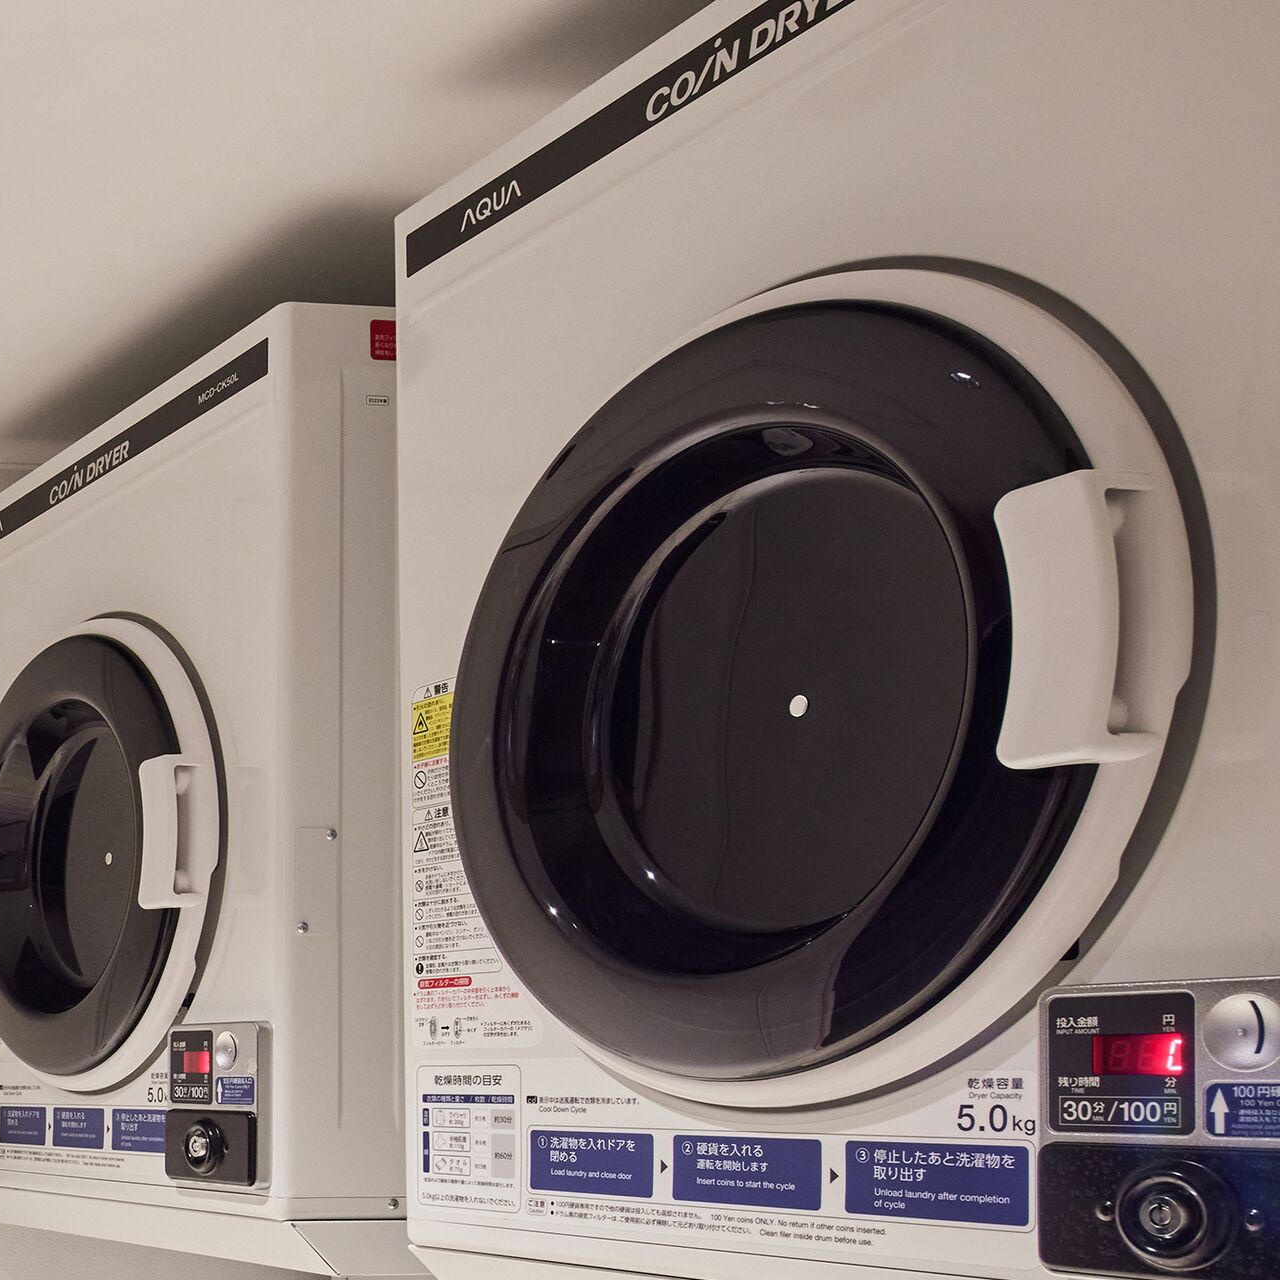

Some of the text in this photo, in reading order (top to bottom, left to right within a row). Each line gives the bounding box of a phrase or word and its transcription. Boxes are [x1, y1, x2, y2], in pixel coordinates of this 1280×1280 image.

[461, 180, 521, 233] AQUA
[85, 440, 130, 482] DRYER
[433, 682, 449, 695] 警告
[434, 806, 449, 819] 注意
[1056, 1016, 1099, 1028] 投入金額
[1162, 1014, 1175, 1026] 円
[434, 1074, 503, 1086] 乾燥時間の目安
[967, 1077, 1024, 1090] 乾燥容量
[1058, 1076, 1100, 1088] 残り時間
[1164, 1076, 1177, 1088] 分
[147, 1087, 164, 1103] 5.0
[968, 1091, 1023, 1101] Dryer Capacity
[1240, 1099, 1275, 1107] 100 Yen
[539, 1105, 552, 1113] Cool
[570, 1106, 587, 1115] Cycle
[494, 1116, 512, 1124] 約30分
[957, 1104, 1036, 1136] 5.0 kg
[549, 1136, 636, 1152] 洗濯物を入れドアを
[696, 1142, 764, 1157] 硬貨を入れる
[494, 1152, 513, 1161] 約60分
[549, 1150, 578, 1163] 閉める
[873, 1148, 1016, 1169] 停止したあと洗濯物を
[696, 1158, 769, 1172] 運転を開始します
[550, 1168, 633, 1180] Load laundry and close door
[873, 1165, 927, 1182] 取り出す
[696, 1176, 796, 1192] Insert coins to start the cycle
[874, 1187, 1010, 1205] Unload laundry after completion
[873, 1199, 906, 1210] of cycle
[710, 1213, 722, 1221] 100
[723, 1214, 735, 1222] Yen
[736, 1216, 754, 1225] coins
[755, 1217, 776, 1226] ONLY.
[777, 1219, 788, 1227] No
[789, 1220, 808, 1229] return
[816, 1222, 834, 1231] other
[835, 1224, 855, 1233] coins
[856, 1226, 887, 1236] inserted.
[759, 1228, 778, 1238] Clean
[793, 1231, 813, 1240] inside
[814, 1233, 833, 1242] drum
[834, 1235, 857, 1246] before
[858, 1238, 873, 1247] use.
